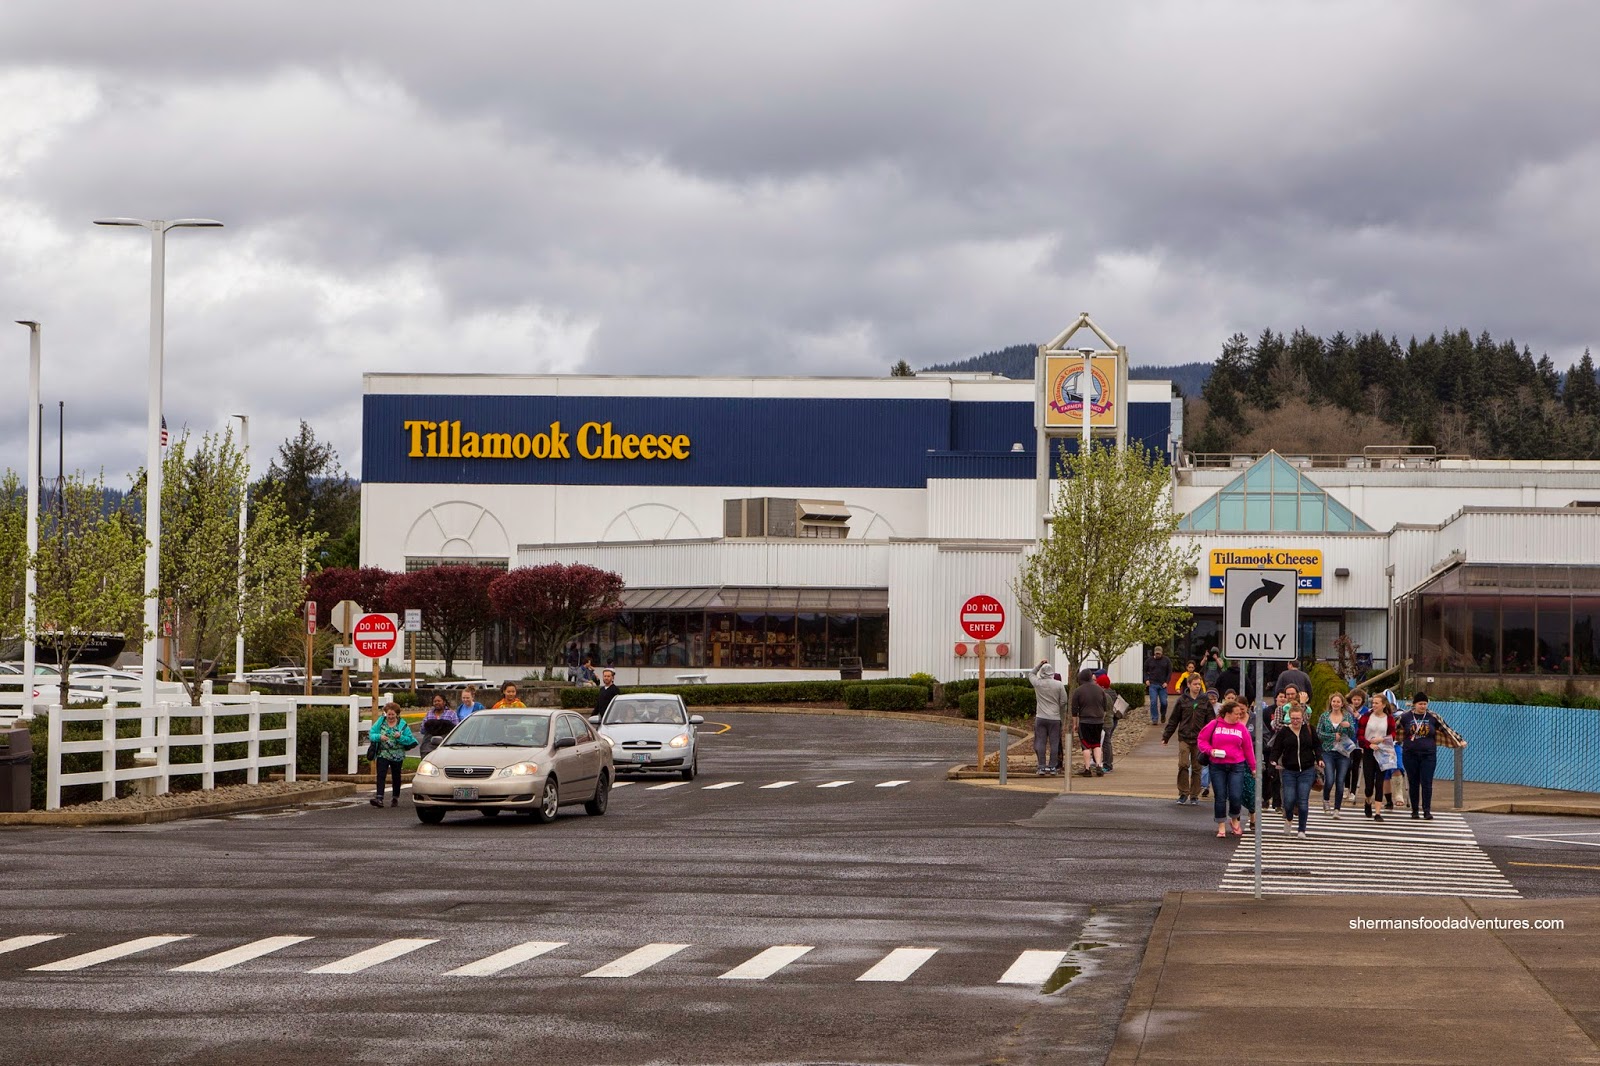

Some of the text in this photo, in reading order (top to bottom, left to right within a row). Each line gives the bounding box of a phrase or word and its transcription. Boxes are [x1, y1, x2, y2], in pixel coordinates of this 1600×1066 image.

[1060, 403, 1082, 412] FARMER
[404, 420, 691, 460] Tillamook Cheese
[1214, 552, 1319, 565] Tillamook Cheese
[1235, 633, 1286, 650] ONLY
